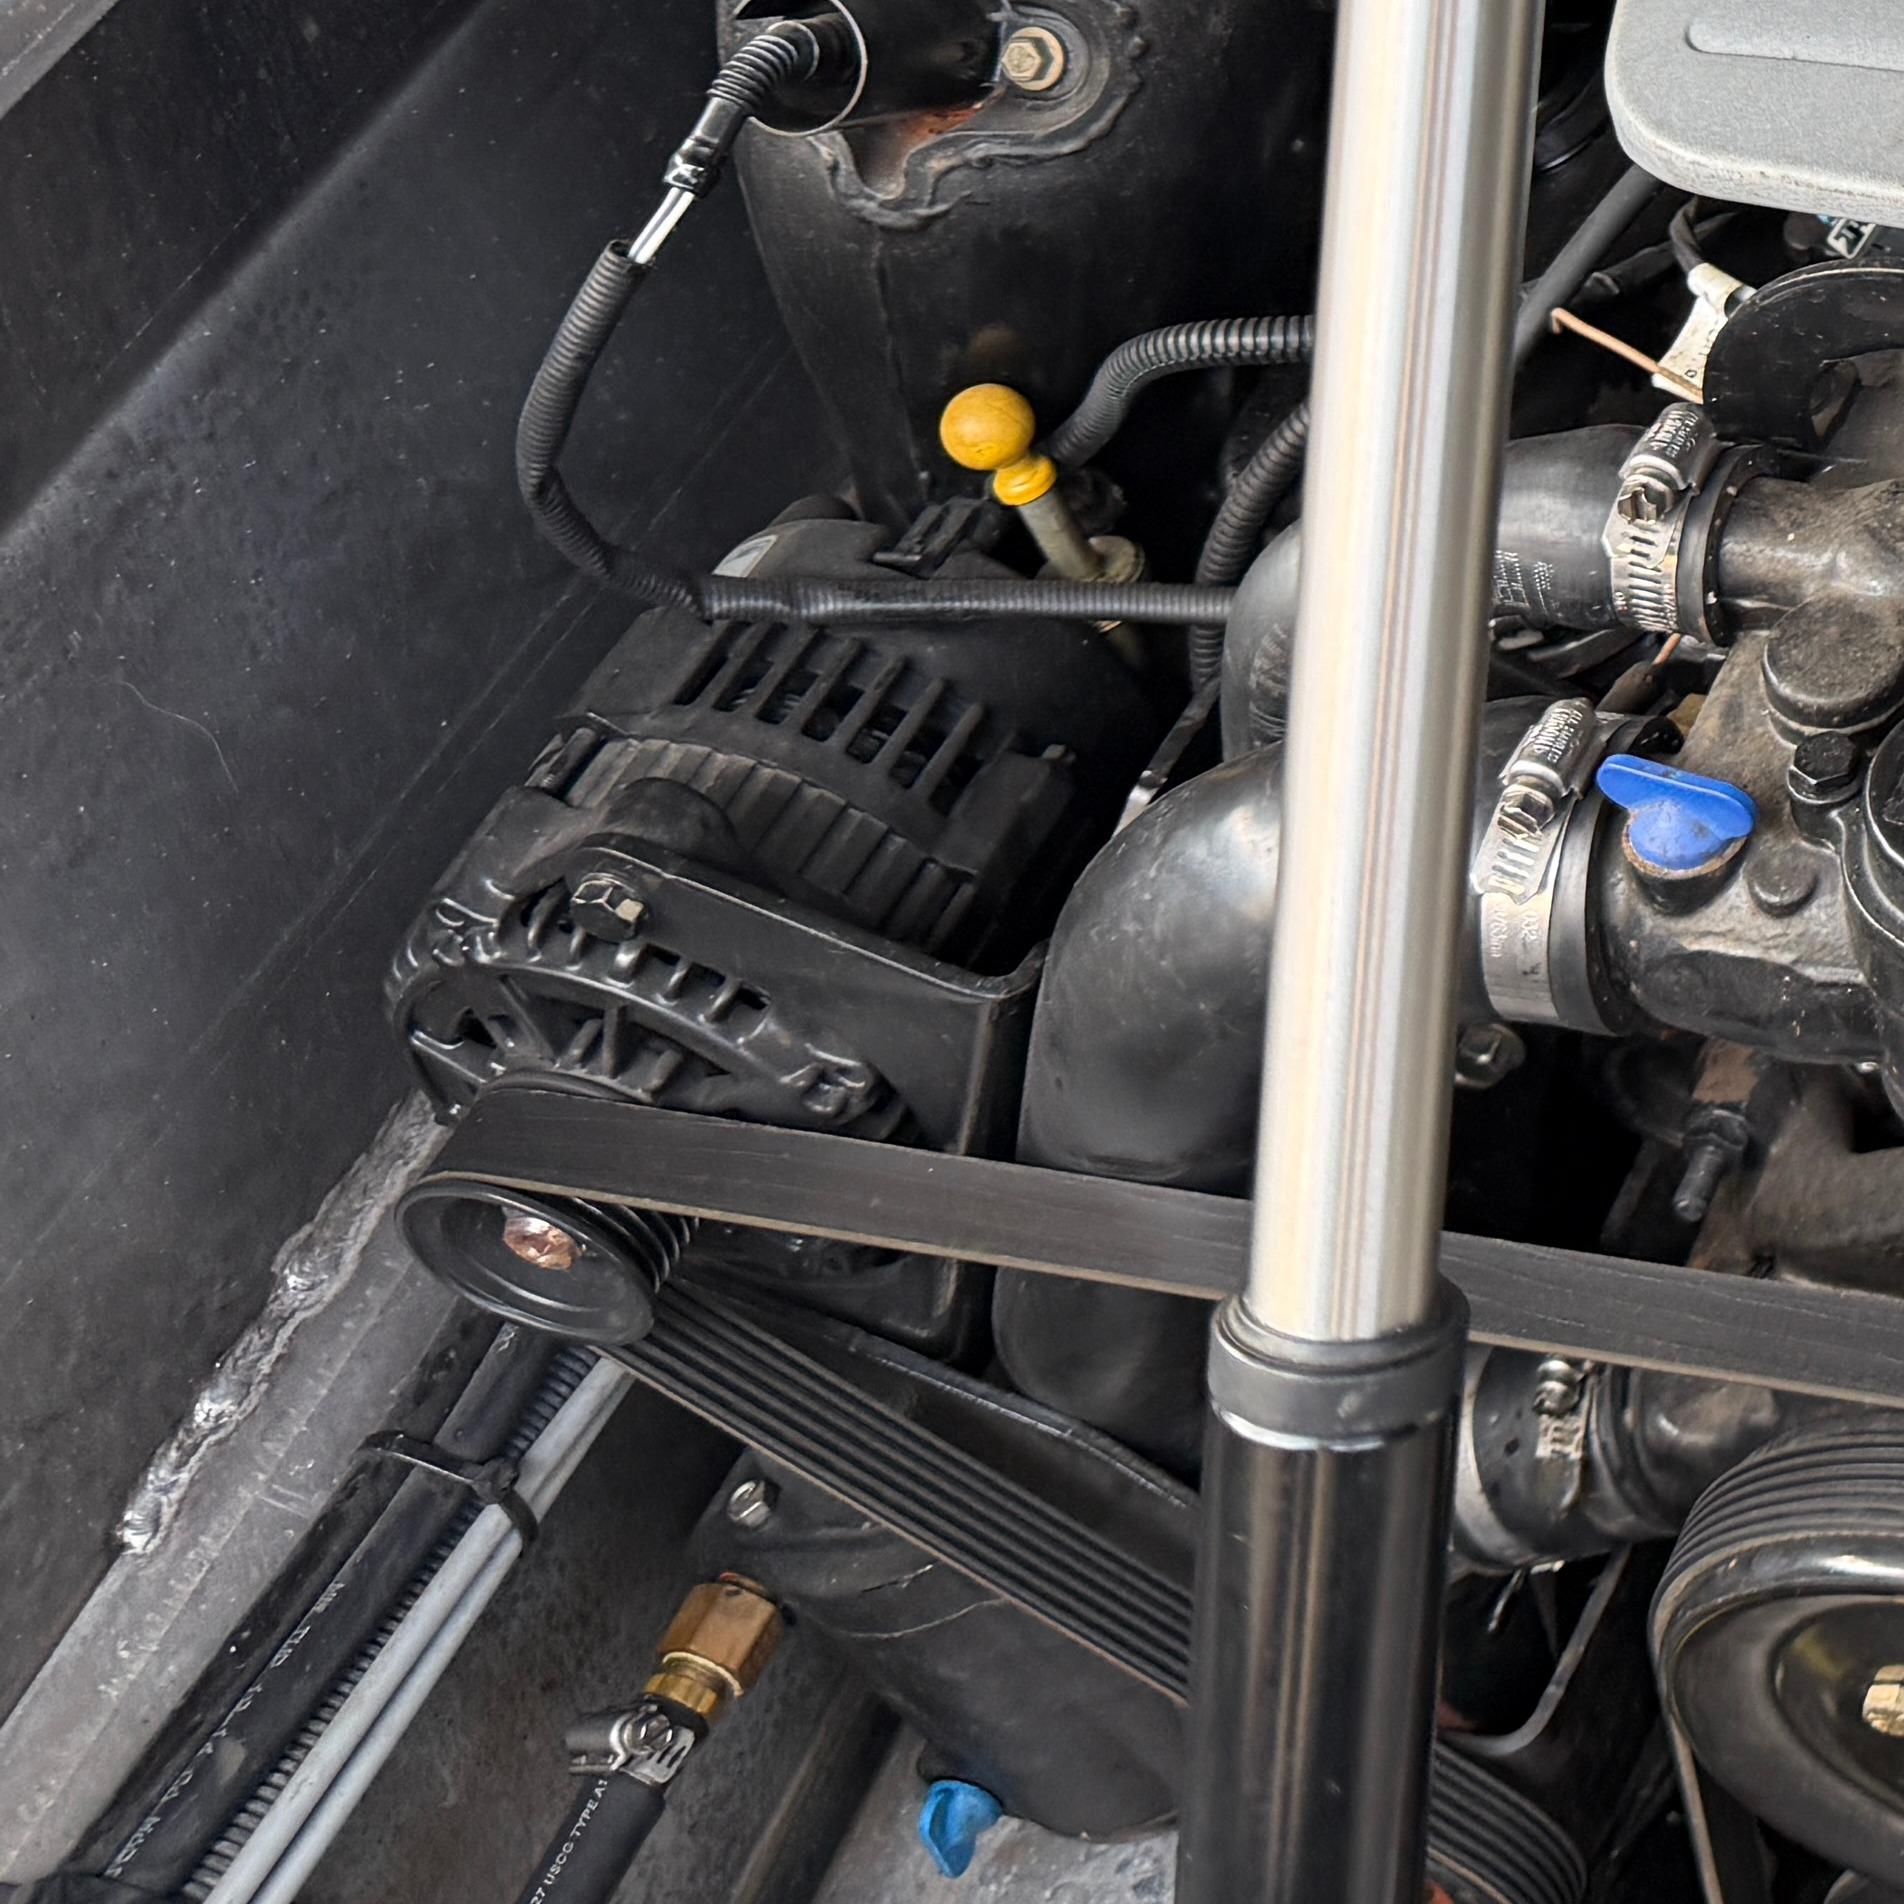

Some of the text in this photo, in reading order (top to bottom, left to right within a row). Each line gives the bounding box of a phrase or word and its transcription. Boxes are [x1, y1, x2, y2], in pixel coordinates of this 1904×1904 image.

[543, 1842, 574, 1885] USCG
[570, 1799, 600, 1837] TYPE
[594, 1779, 608, 1798] A1
